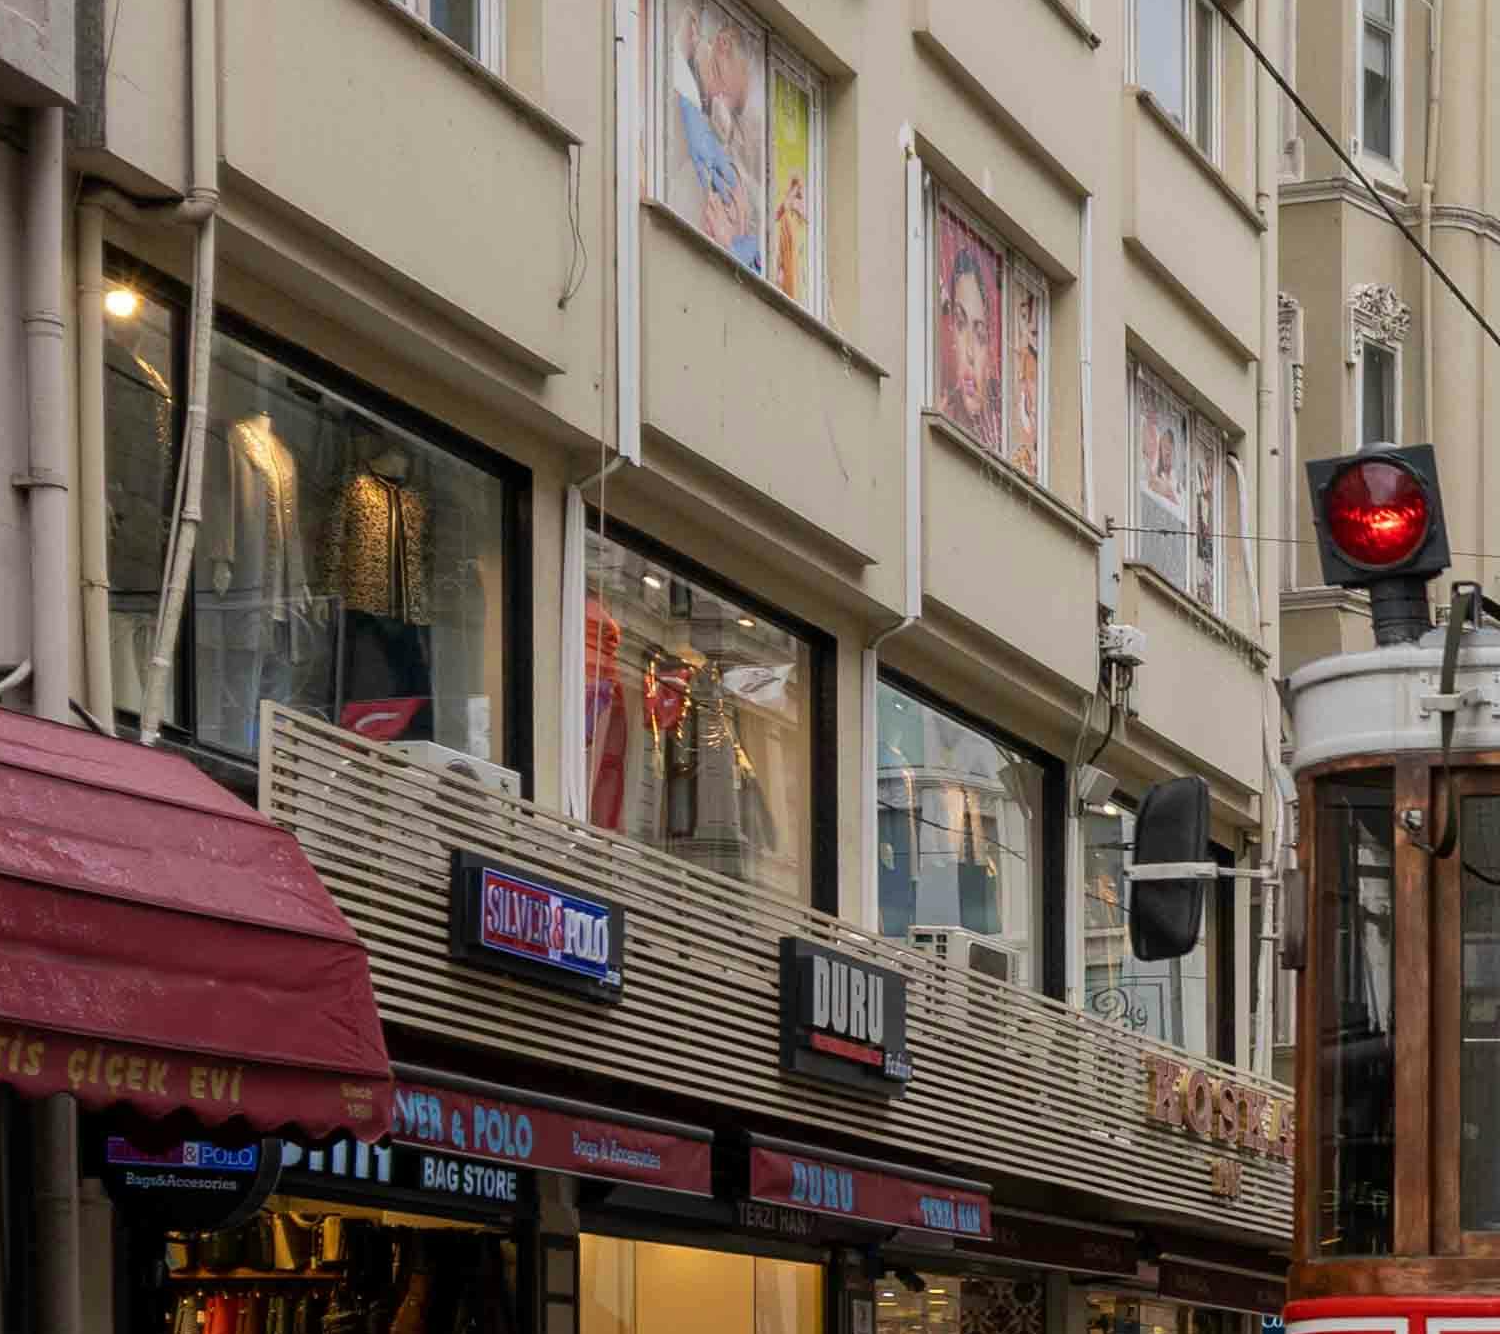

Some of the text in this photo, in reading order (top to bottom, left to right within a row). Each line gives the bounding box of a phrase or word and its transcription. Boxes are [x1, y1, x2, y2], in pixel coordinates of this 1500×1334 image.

[813, 954, 884, 1044] DURU
[201, 1146, 253, 1166] POLO
[452, 1108, 467, 1149] &
[474, 1104, 533, 1159] POLO
[423, 1155, 459, 1192] BAG
[463, 1163, 518, 1202] STORE
[791, 1161, 853, 1212] DURU
